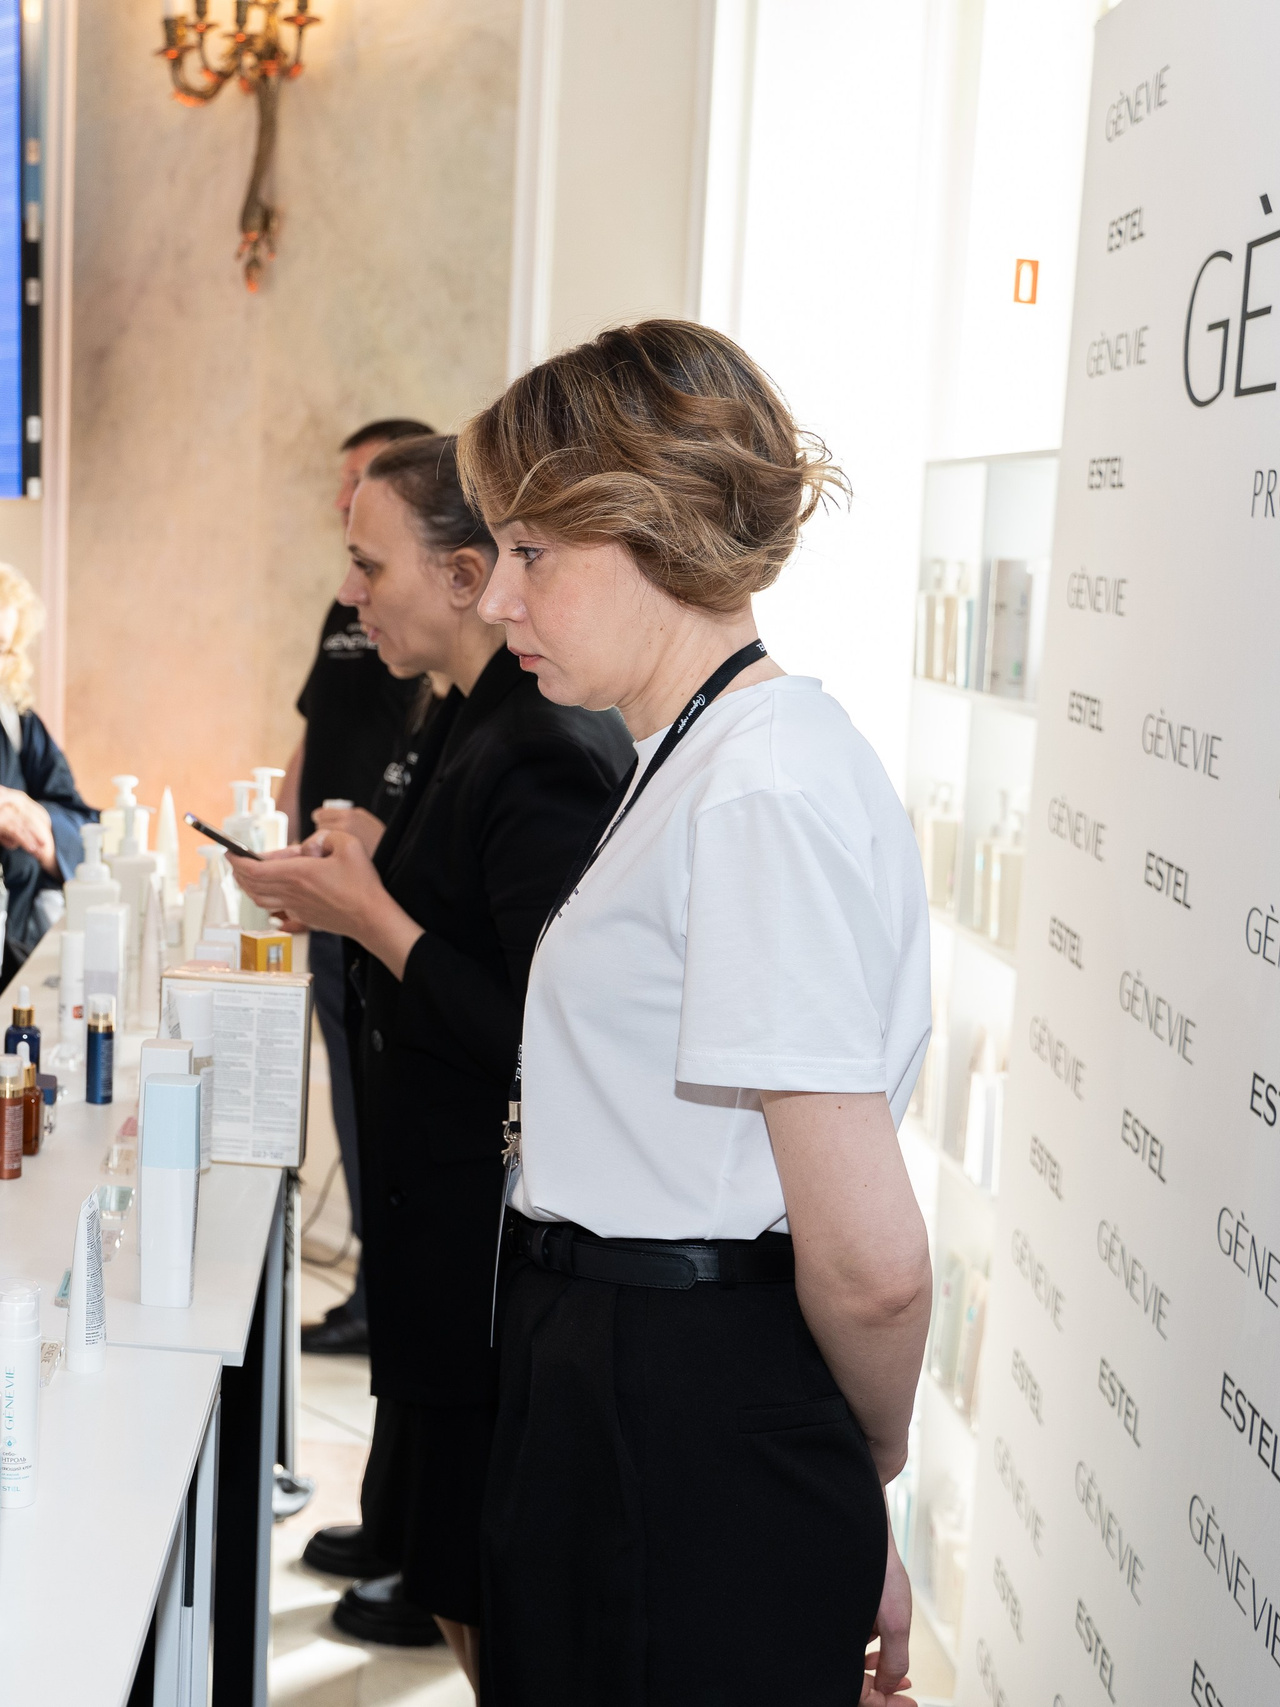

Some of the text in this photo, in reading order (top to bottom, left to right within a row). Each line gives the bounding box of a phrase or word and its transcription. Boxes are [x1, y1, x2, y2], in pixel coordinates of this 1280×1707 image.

[1108, 207, 1145, 253] ESTEL
[1088, 457, 1124, 490] ESTEL
[1251, 469, 1280, 518] PR
[1068, 691, 1103, 732] ESTEL
[1145, 851, 1191, 910] ESTEL
[1121, 1109, 1166, 1184] ESTEL
[1098, 1358, 1141, 1448] ESTEL
[1075, 1599, 1116, 1704] ESTEL
